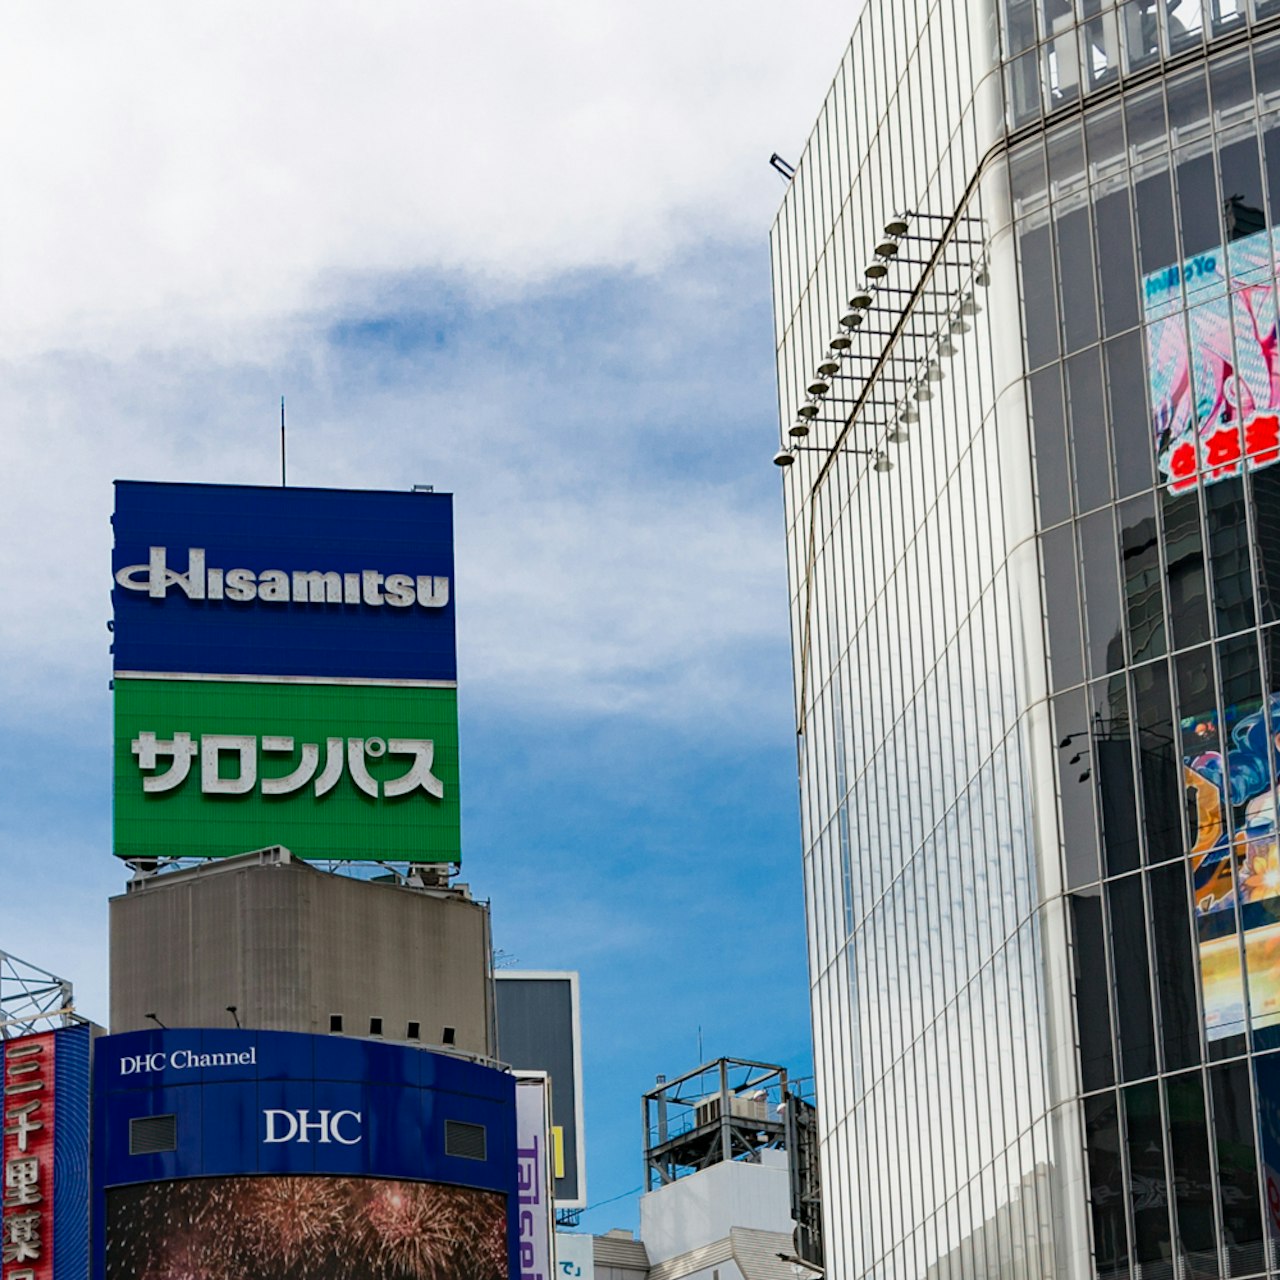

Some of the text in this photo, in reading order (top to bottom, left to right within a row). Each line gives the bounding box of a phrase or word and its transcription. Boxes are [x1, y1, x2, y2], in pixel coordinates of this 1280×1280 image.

[116, 546, 448, 607] Hisamitsu
[131, 732, 443, 799] サロンパス
[120, 1047, 256, 1075] DHC Channel
[263, 1109, 362, 1144] DHC
